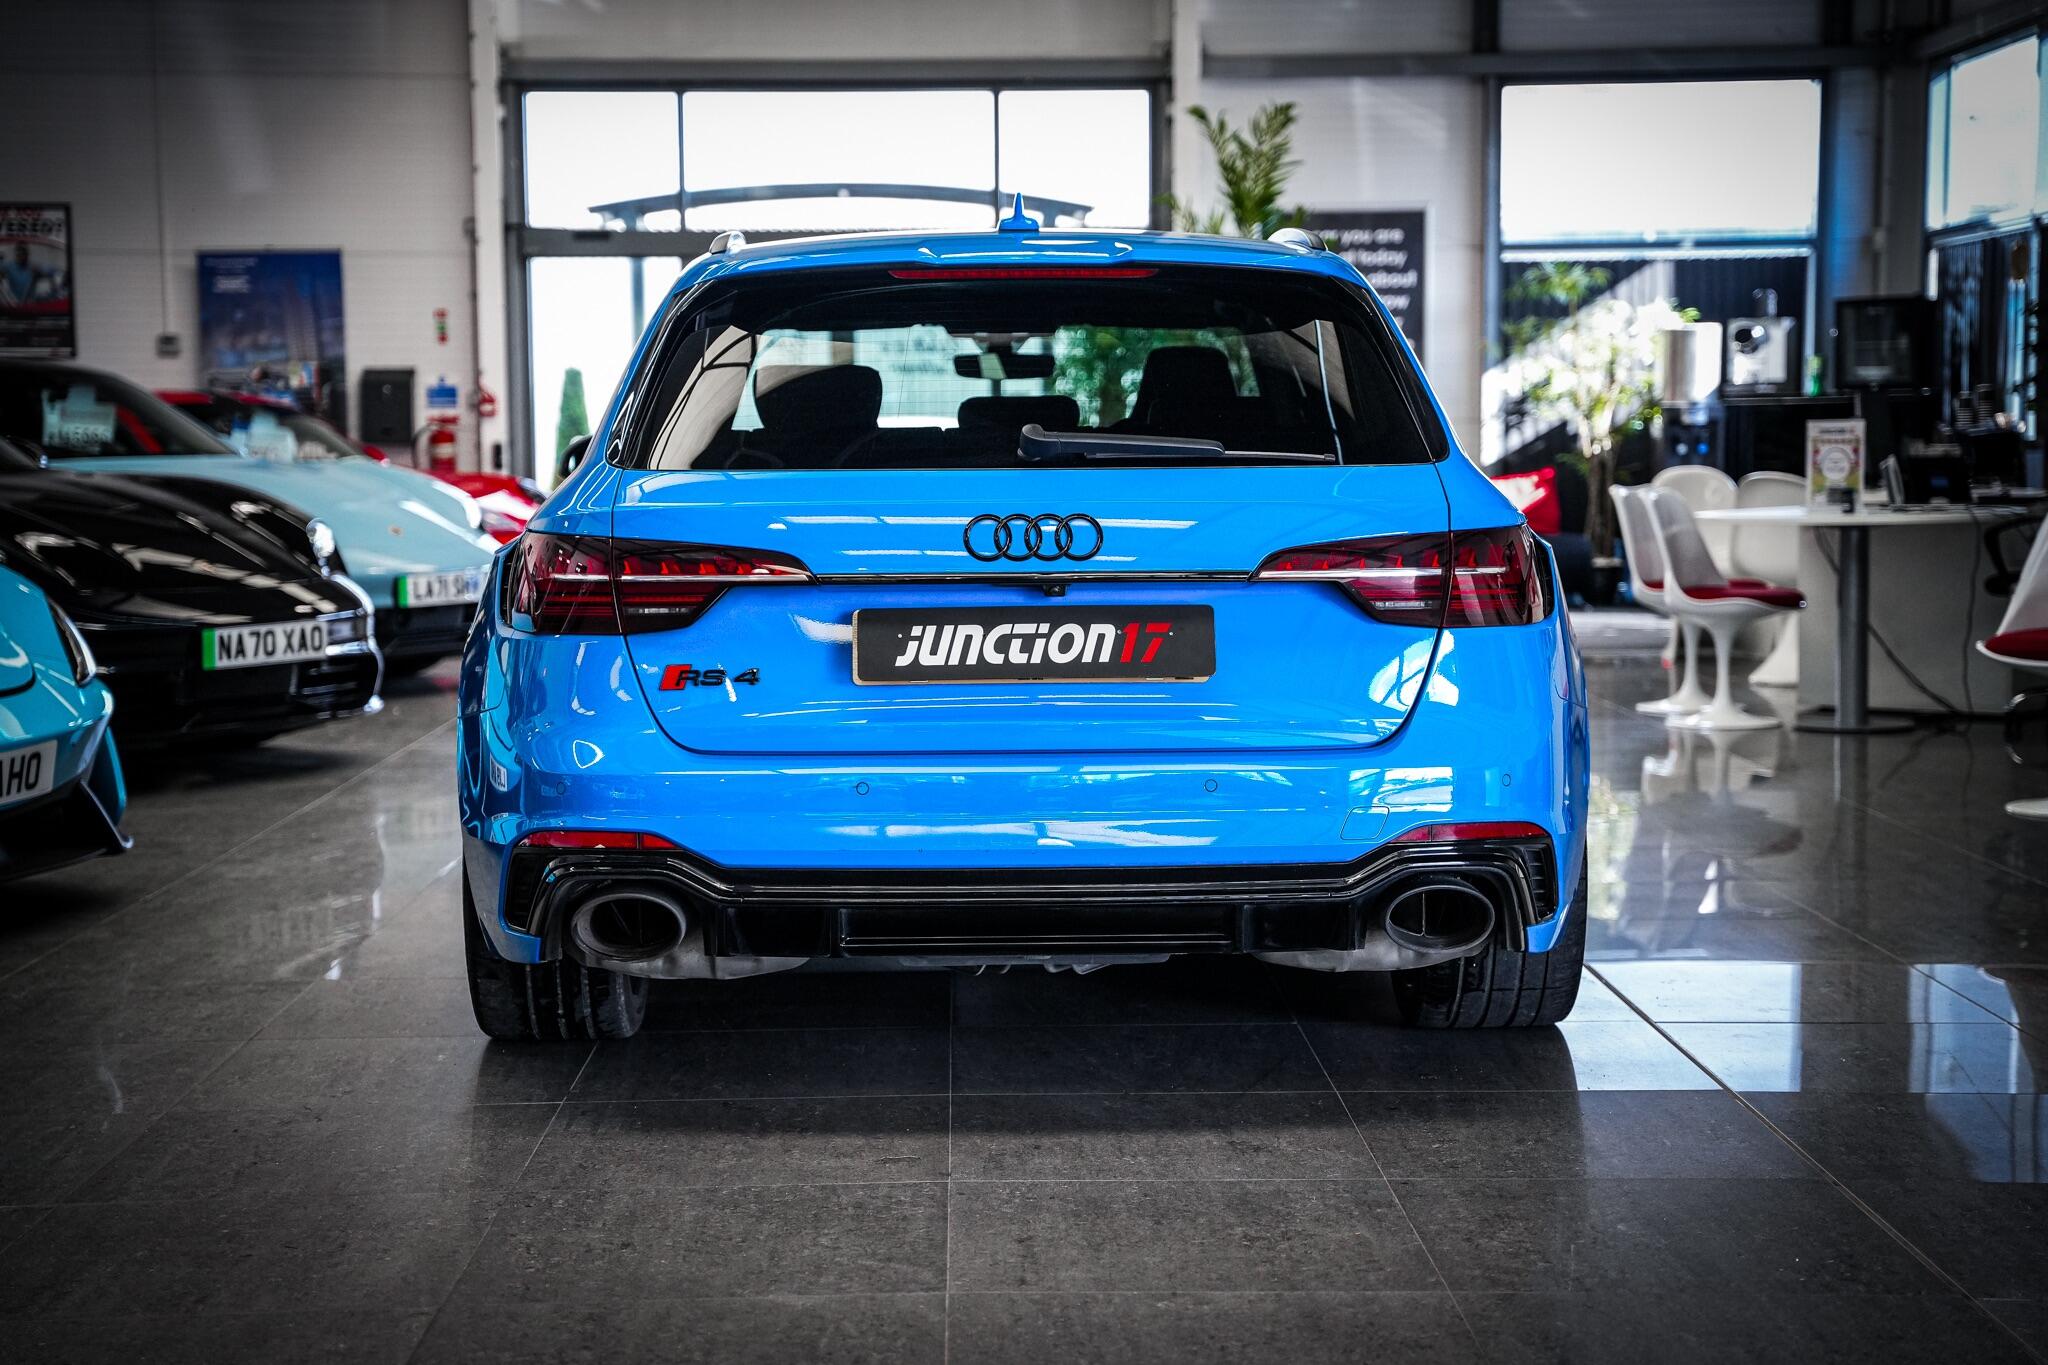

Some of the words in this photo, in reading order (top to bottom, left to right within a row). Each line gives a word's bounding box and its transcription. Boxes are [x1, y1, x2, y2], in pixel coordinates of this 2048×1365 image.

[1341, 229, 1373, 248] you
[1374, 228, 1405, 244] are
[1358, 248, 1408, 269] today
[218, 630, 276, 661] NA70
[673, 668, 727, 687] RS
[734, 667, 760, 686] 4
